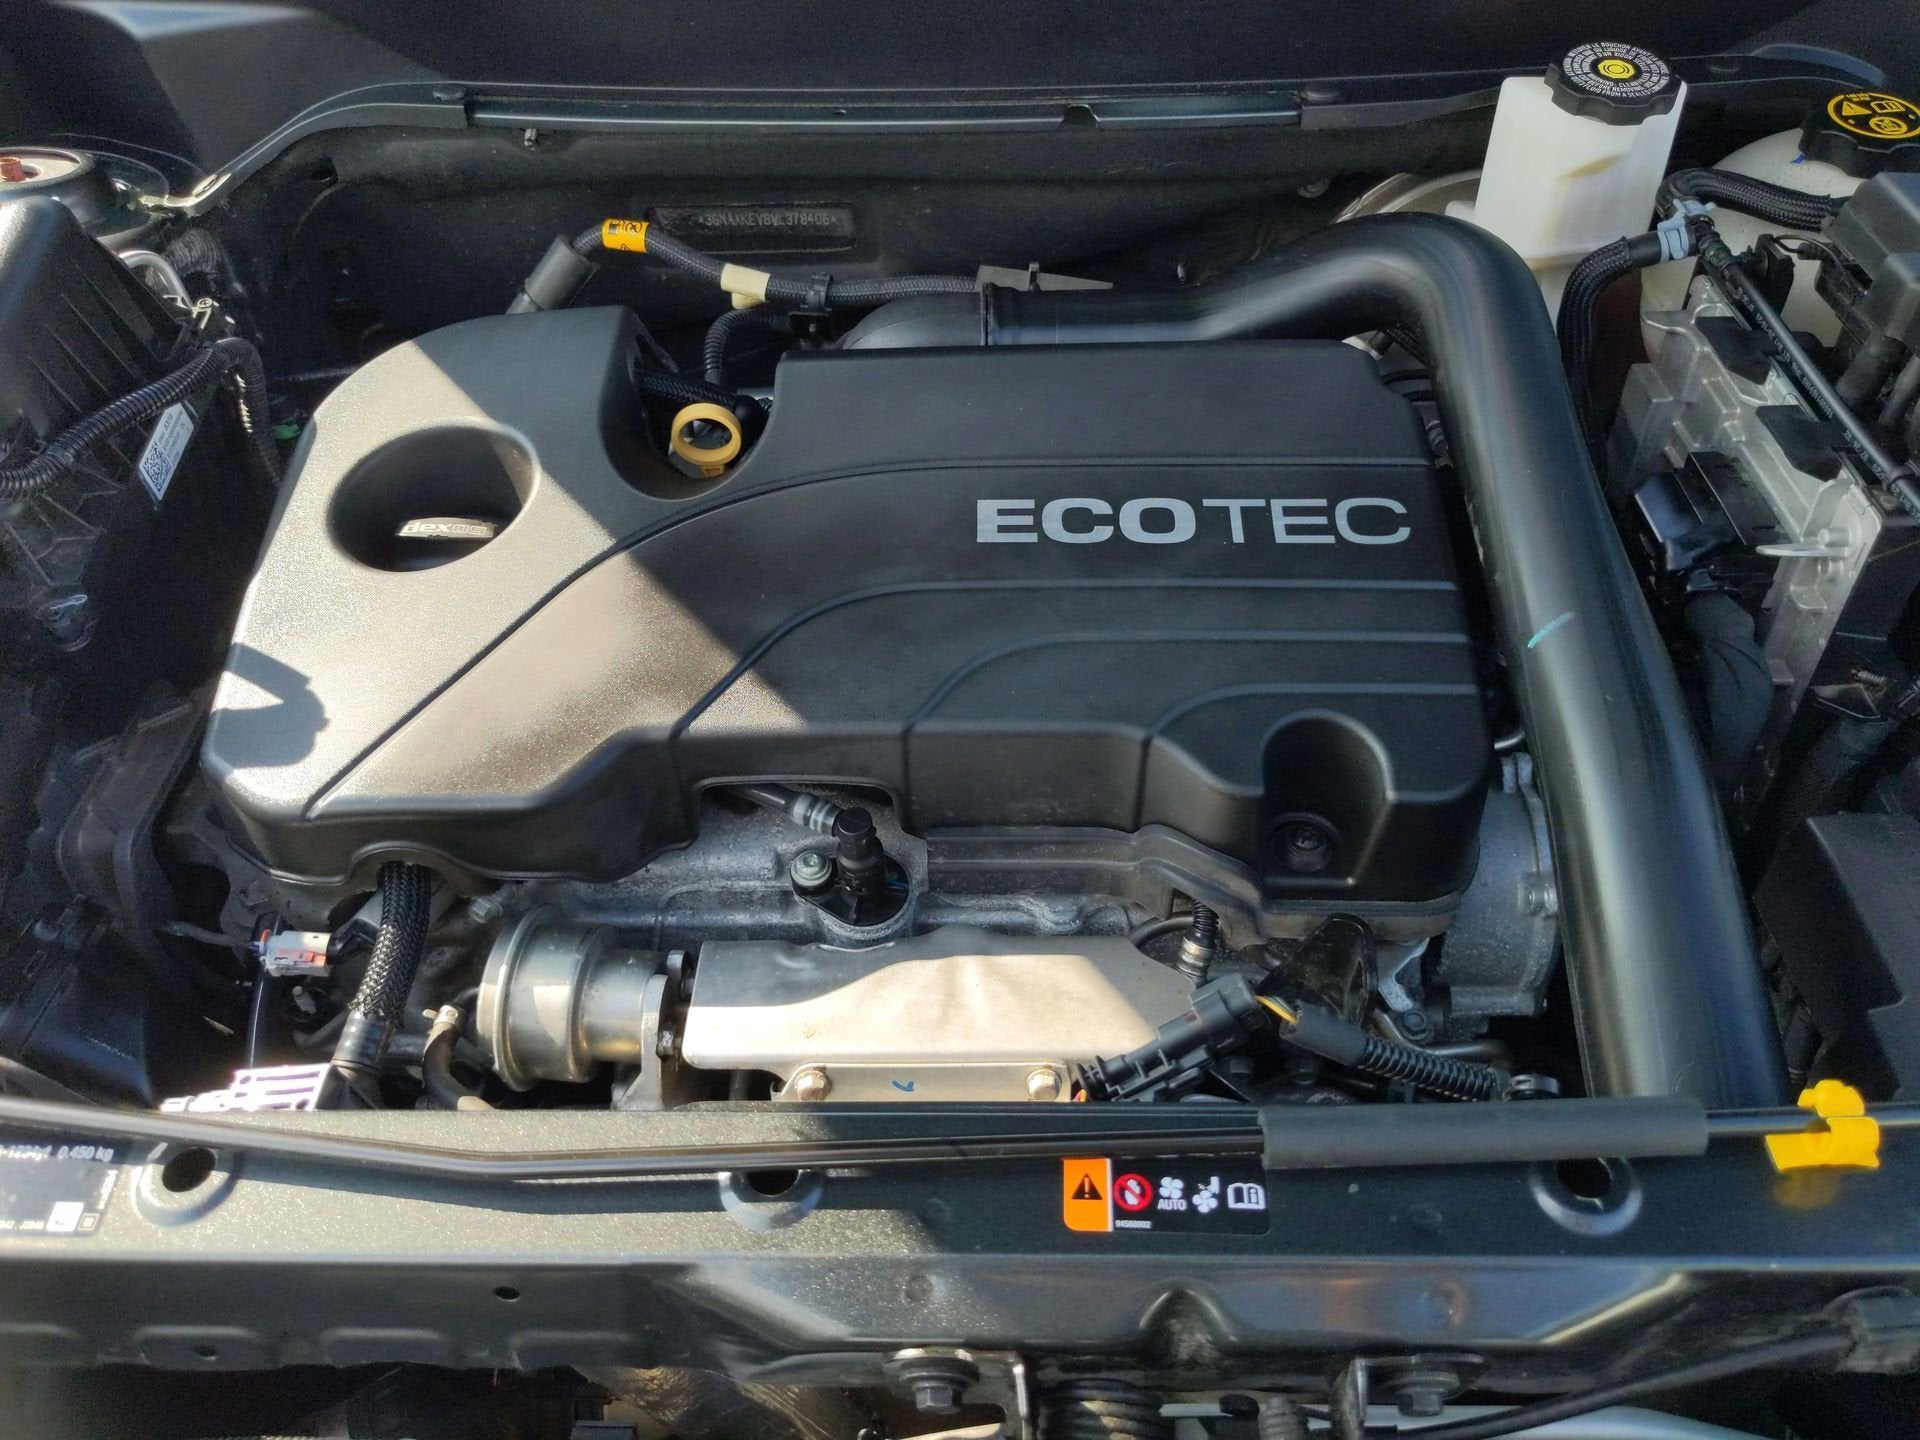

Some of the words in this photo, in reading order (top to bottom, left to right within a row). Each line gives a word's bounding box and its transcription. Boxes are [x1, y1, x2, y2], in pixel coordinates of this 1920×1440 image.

[977, 498, 1411, 544] ECOTEC
[406, 522, 487, 536] dexos
[58, 1146, 96, 1160] 0.450
[96, 1146, 114, 1162] kg
[1158, 1199, 1187, 1211] AUTO
